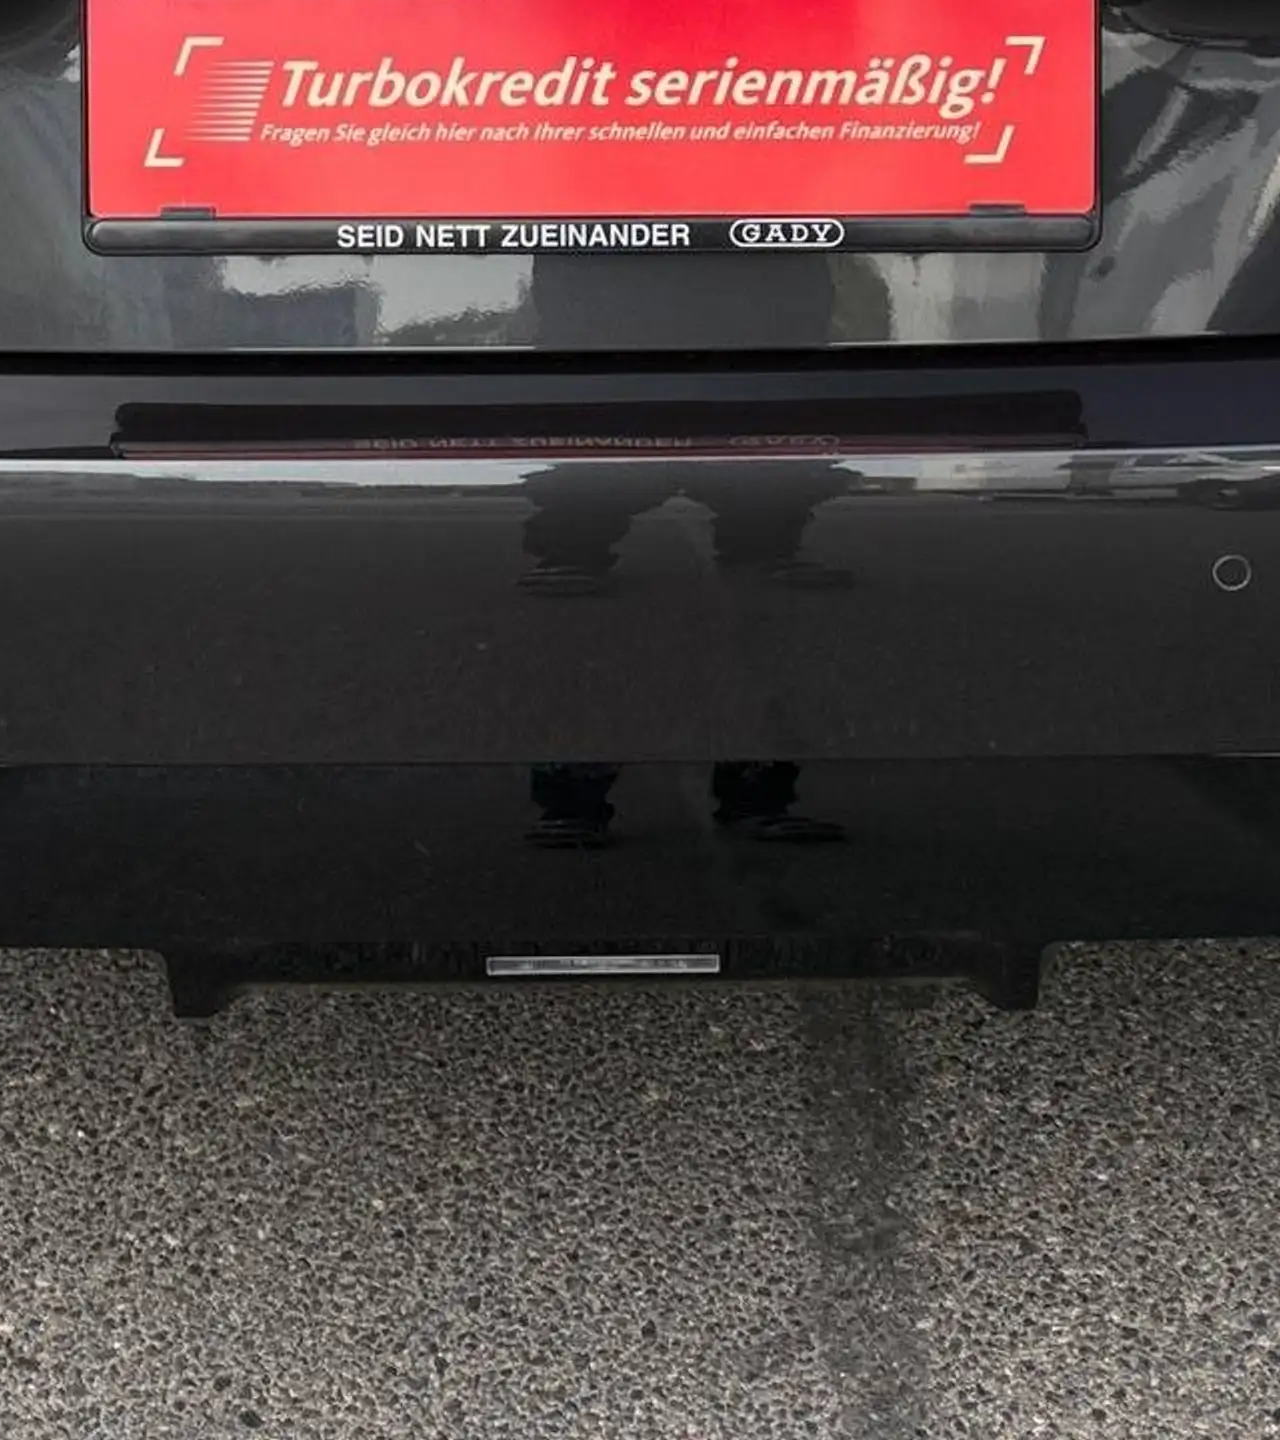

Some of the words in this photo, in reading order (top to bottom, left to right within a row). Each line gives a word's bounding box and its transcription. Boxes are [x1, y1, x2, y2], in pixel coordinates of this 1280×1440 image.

[282, 56, 617, 108] Turbokredit
[624, 53, 1007, 120] serienmäßig!
[260, 123, 331, 147] Fragen
[336, 122, 366, 142] Sie
[369, 122, 431, 147] gleich
[435, 122, 477, 142] hier
[480, 122, 531, 142] nach
[534, 122, 584, 141] Ihrer
[590, 121, 685, 142] schnellen
[689, 122, 730, 141] und
[733, 120, 834, 140] einfachen
[838, 120, 981, 145] Finanzierung!
[337, 224, 404, 249] SEID
[416, 224, 491, 248] NETT
[501, 223, 691, 248] ZUEINANDER
[741, 224, 832, 243] GADY
